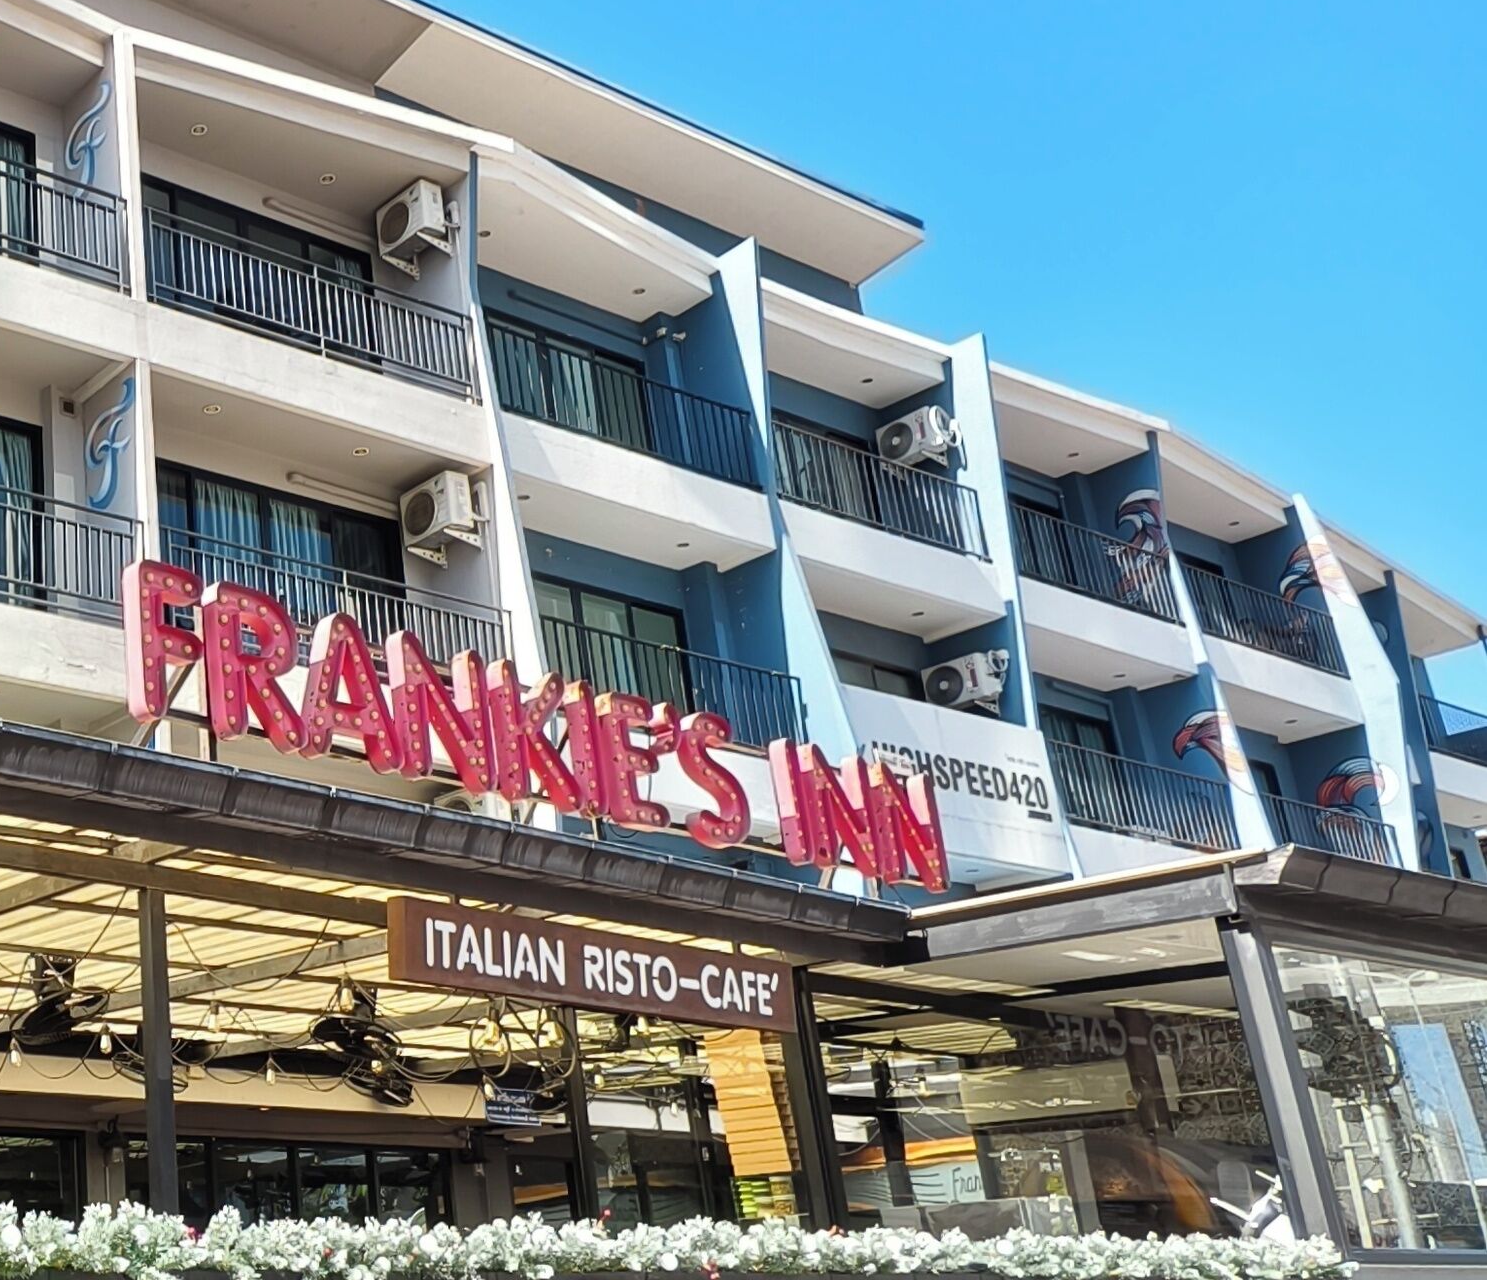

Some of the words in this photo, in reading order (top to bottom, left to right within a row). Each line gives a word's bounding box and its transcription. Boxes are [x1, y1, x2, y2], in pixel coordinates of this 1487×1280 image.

[122, 559, 751, 850] FRANKIE'S
[769, 737, 948, 893] INN
[871, 741, 1050, 810] GHSPEED420
[425, 917, 566, 987] ITALIAN
